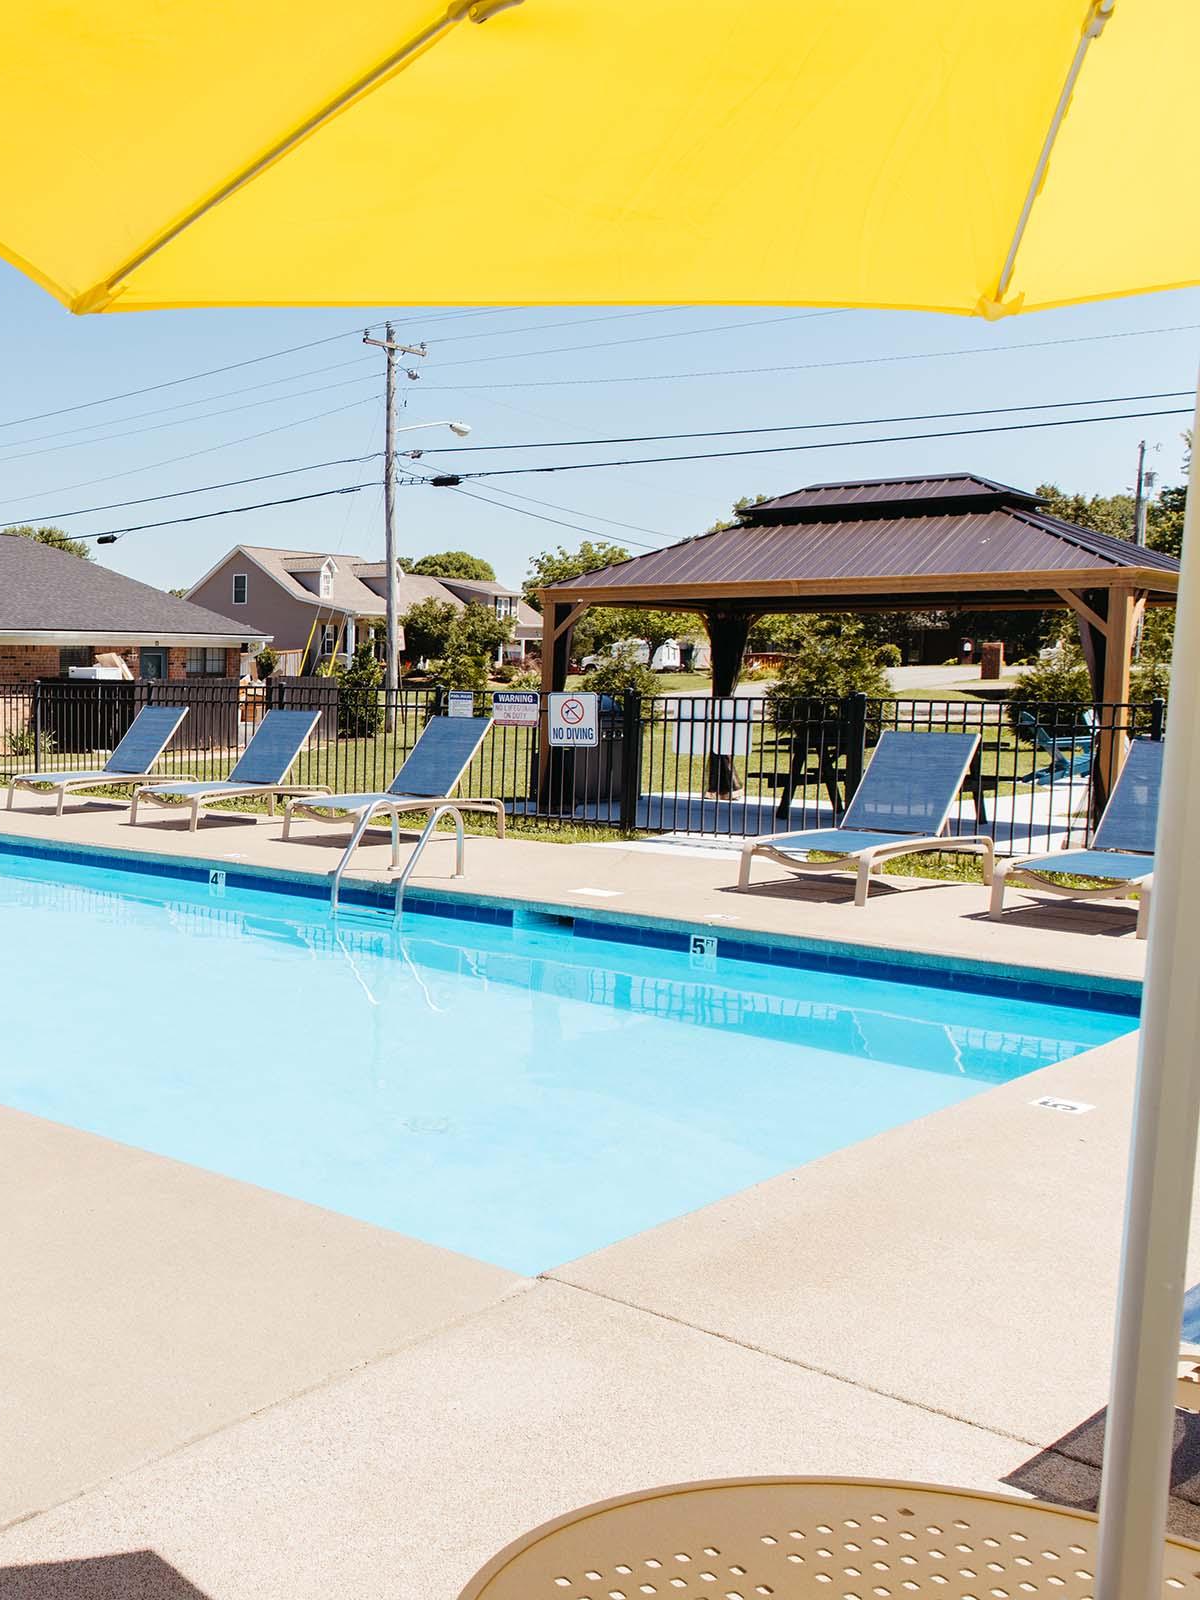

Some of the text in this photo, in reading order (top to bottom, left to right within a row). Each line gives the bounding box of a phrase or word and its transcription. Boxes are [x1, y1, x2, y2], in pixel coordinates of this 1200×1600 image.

[498, 694, 533, 703] WARNING
[553, 727, 594, 740] NO DIVING
[210, 872, 219, 884] 4
[692, 937, 705, 955] 5
